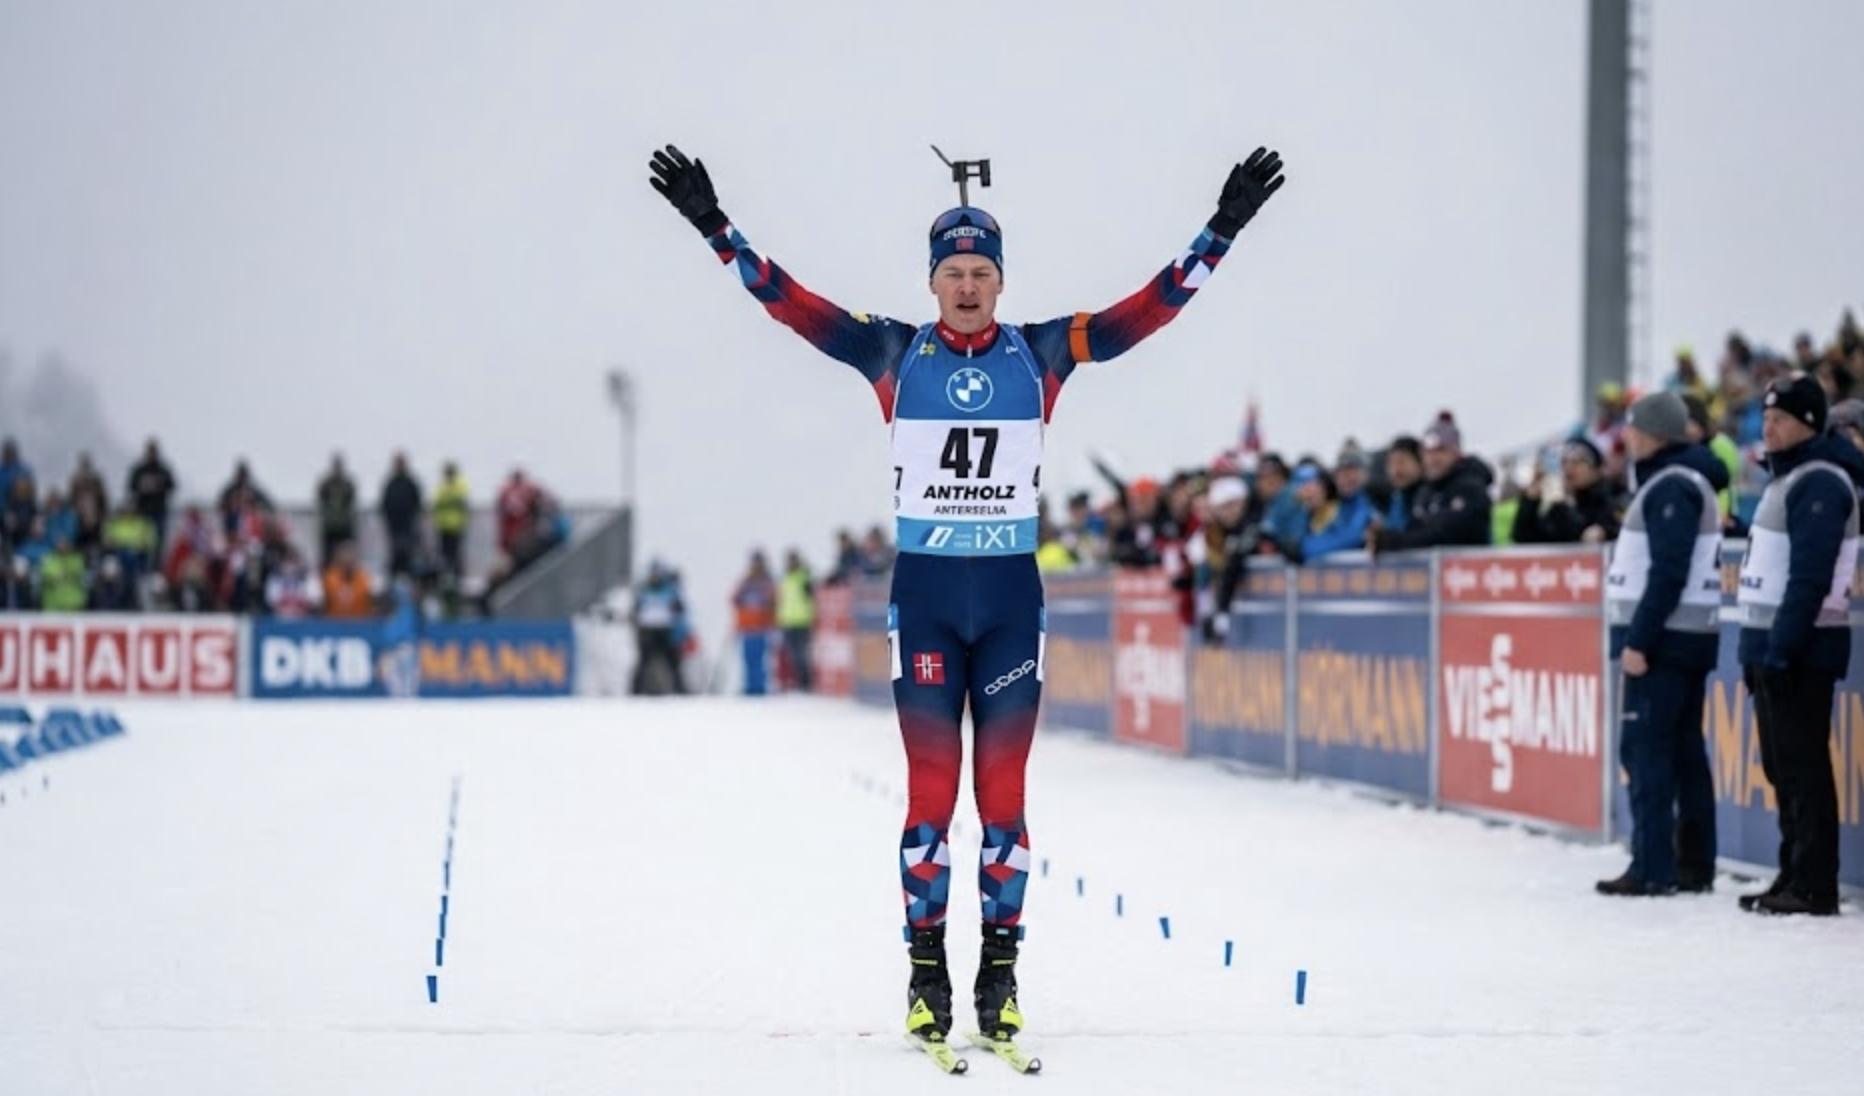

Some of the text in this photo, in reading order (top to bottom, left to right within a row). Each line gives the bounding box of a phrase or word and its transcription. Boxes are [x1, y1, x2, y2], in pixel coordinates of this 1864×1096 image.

[939, 427, 999, 479] 47
[923, 485, 1016, 500] ANTHOLZ
[260, 636, 372, 688] DKB
[419, 641, 567, 687] MANN
